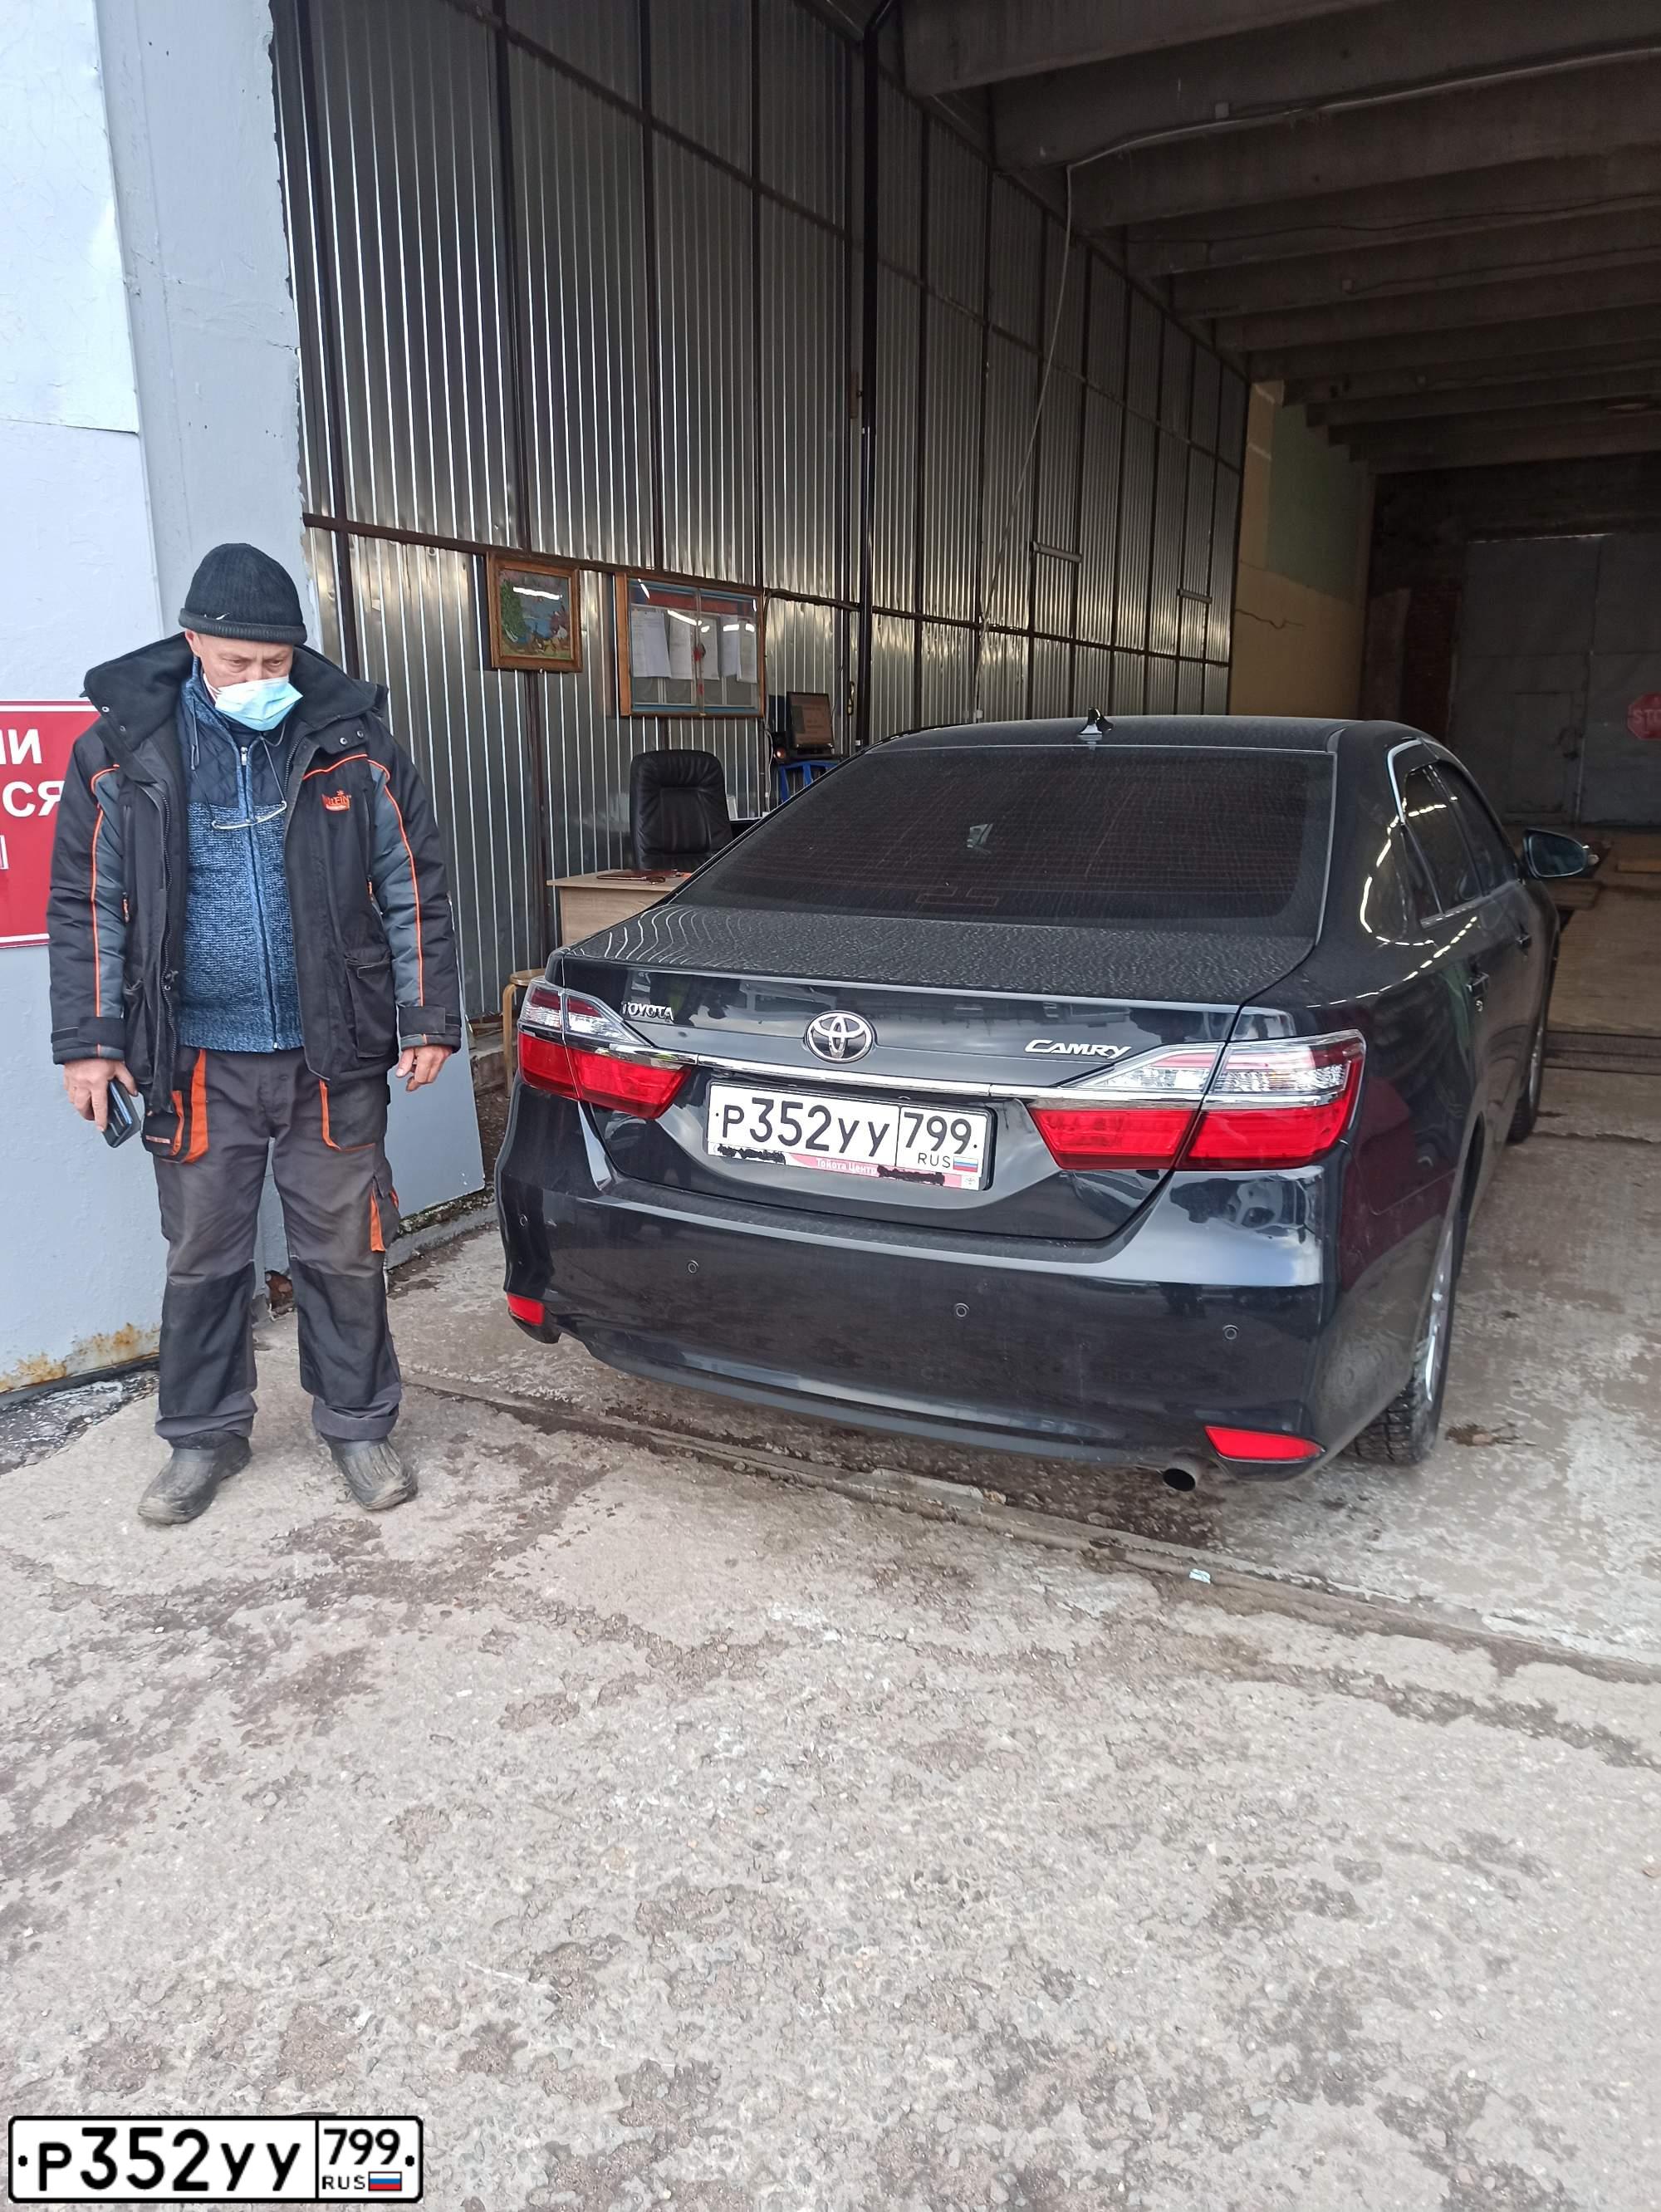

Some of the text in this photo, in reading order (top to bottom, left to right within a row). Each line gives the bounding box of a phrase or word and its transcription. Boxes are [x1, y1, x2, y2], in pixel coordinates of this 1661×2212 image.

[620, 1002, 674, 1021] TOYOTA
[1025, 1039, 1132, 1059] CAMRY
[904, 1111, 972, 1155] 799
[848, 1162, 878, 1176] Центр
[918, 1152, 951, 1169] RUS
